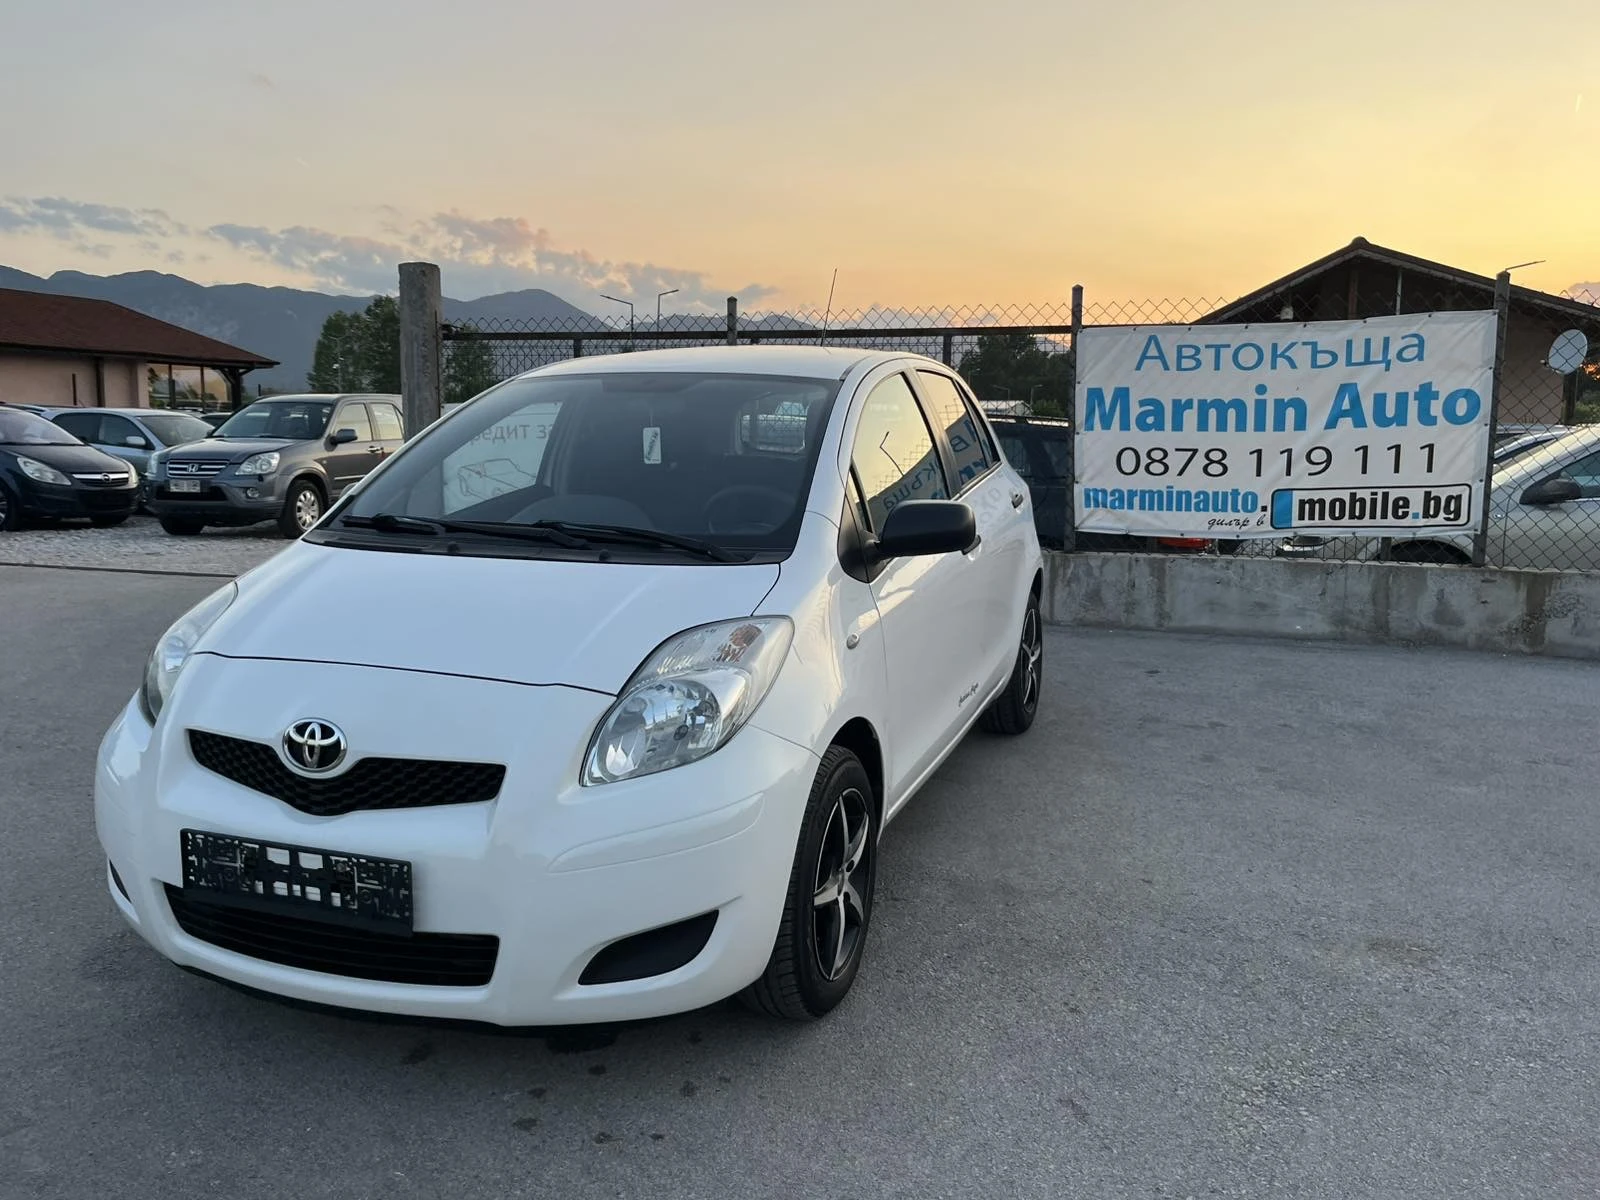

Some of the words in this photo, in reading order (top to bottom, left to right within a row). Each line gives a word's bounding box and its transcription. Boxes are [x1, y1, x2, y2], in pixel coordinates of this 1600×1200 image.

[1135, 333, 1425, 372] Автокъща
[1084, 384, 1308, 432] Marmin
[1324, 381, 1482, 430] Auto
[1115, 446, 1229, 478] 0878
[1249, 445, 1333, 478] 119
[1354, 443, 1436, 475] 111
[1298, 491, 1462, 522] mobile.bg
